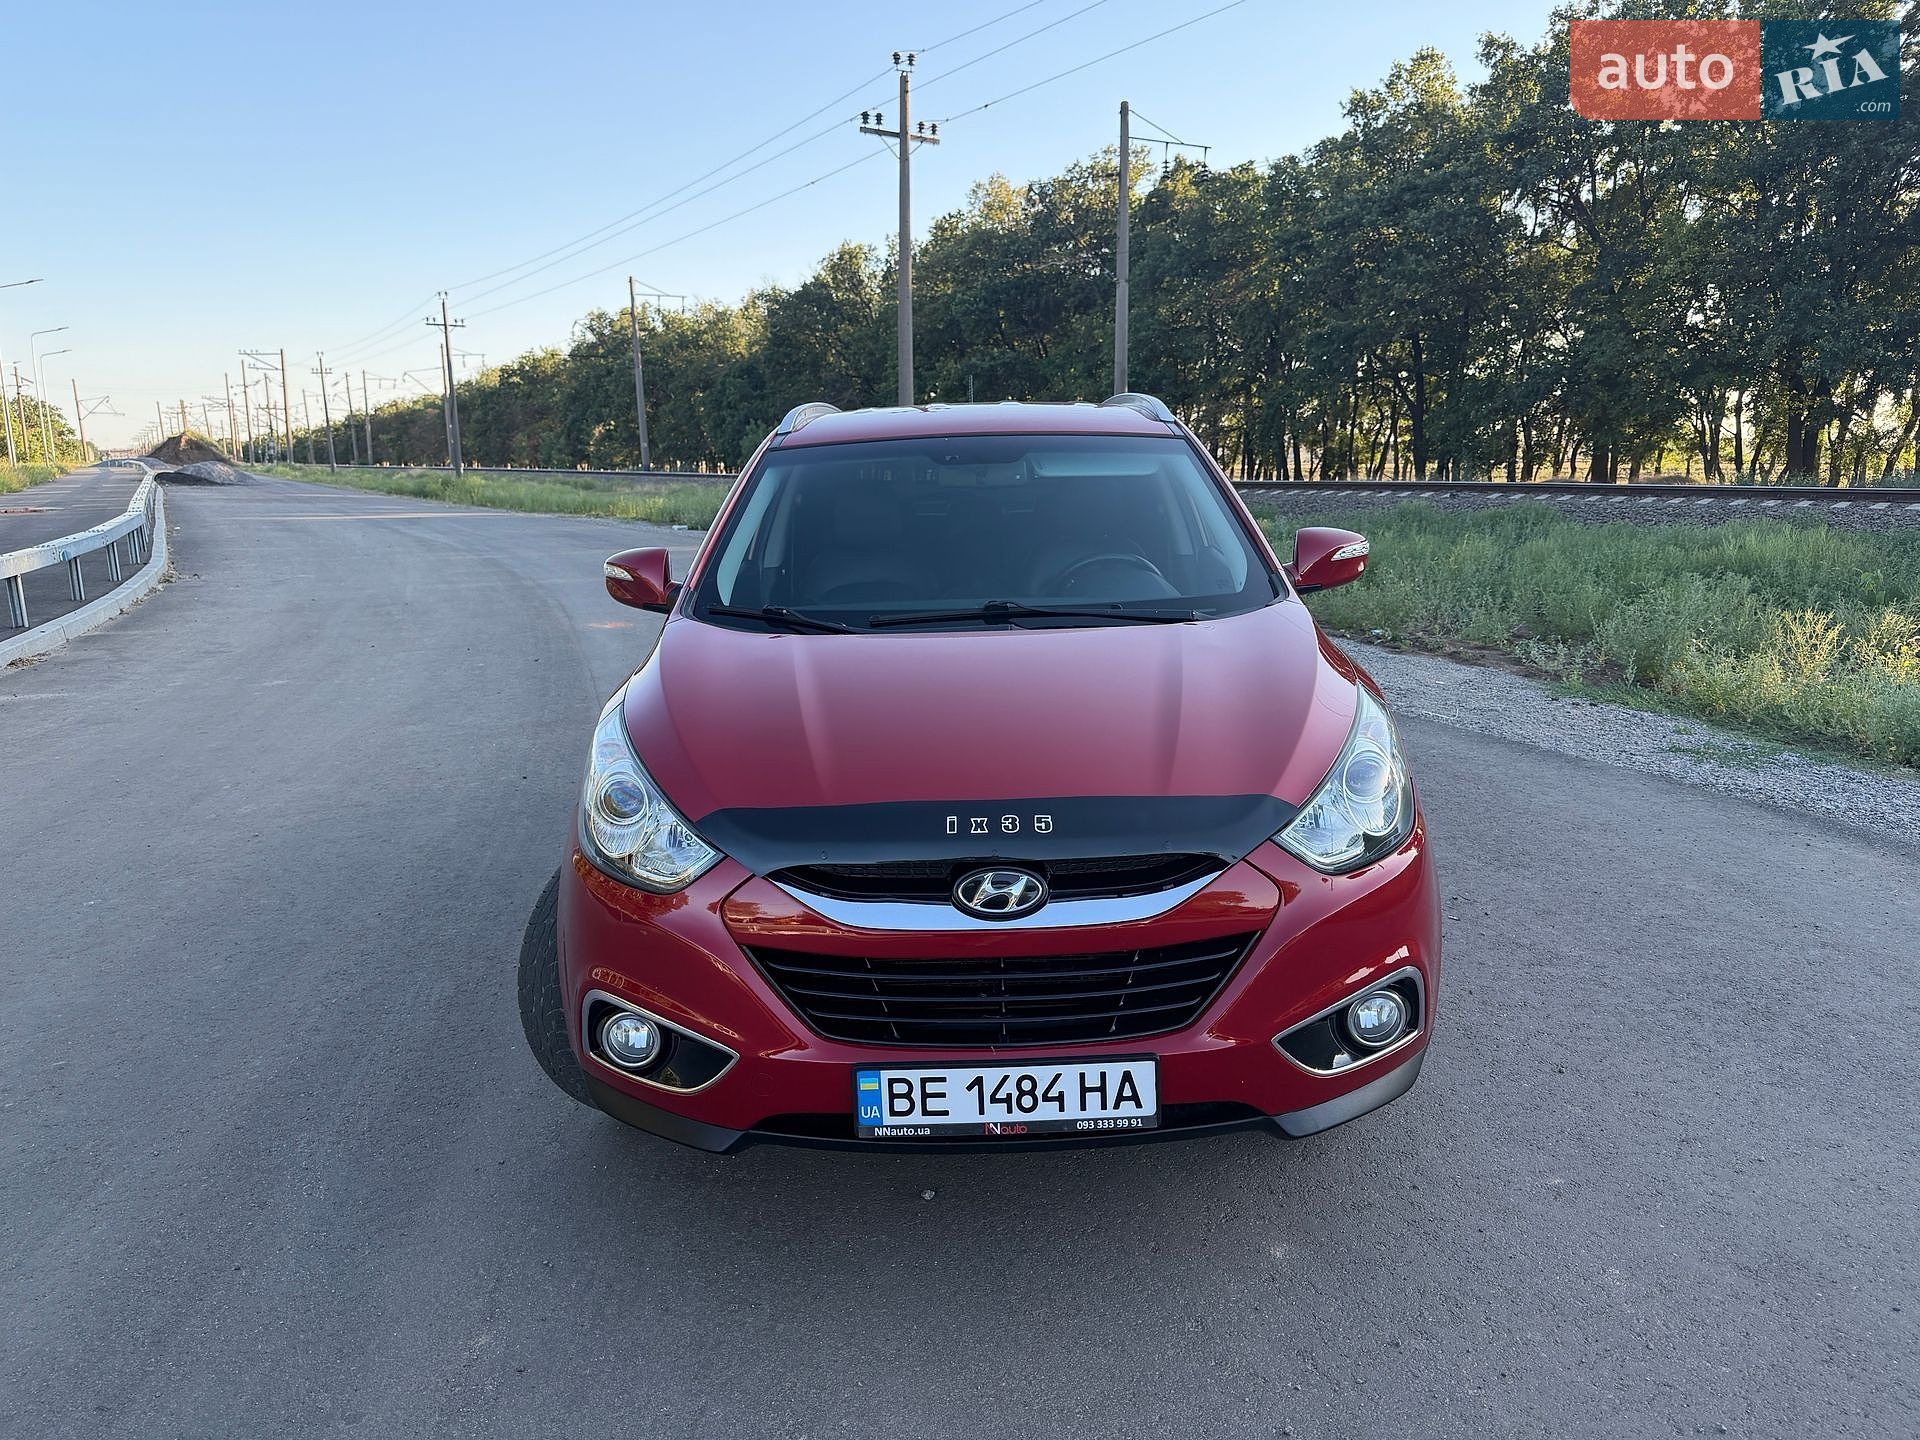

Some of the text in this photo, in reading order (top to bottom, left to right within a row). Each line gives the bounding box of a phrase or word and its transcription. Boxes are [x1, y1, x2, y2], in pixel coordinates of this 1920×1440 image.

[887, 1070, 1144, 1118] BE 1484 HA
[861, 1107, 881, 1119] UA
[1076, 1118, 1143, 1130] 093 333 99 91
[874, 1126, 931, 1136] NNauto.ua
